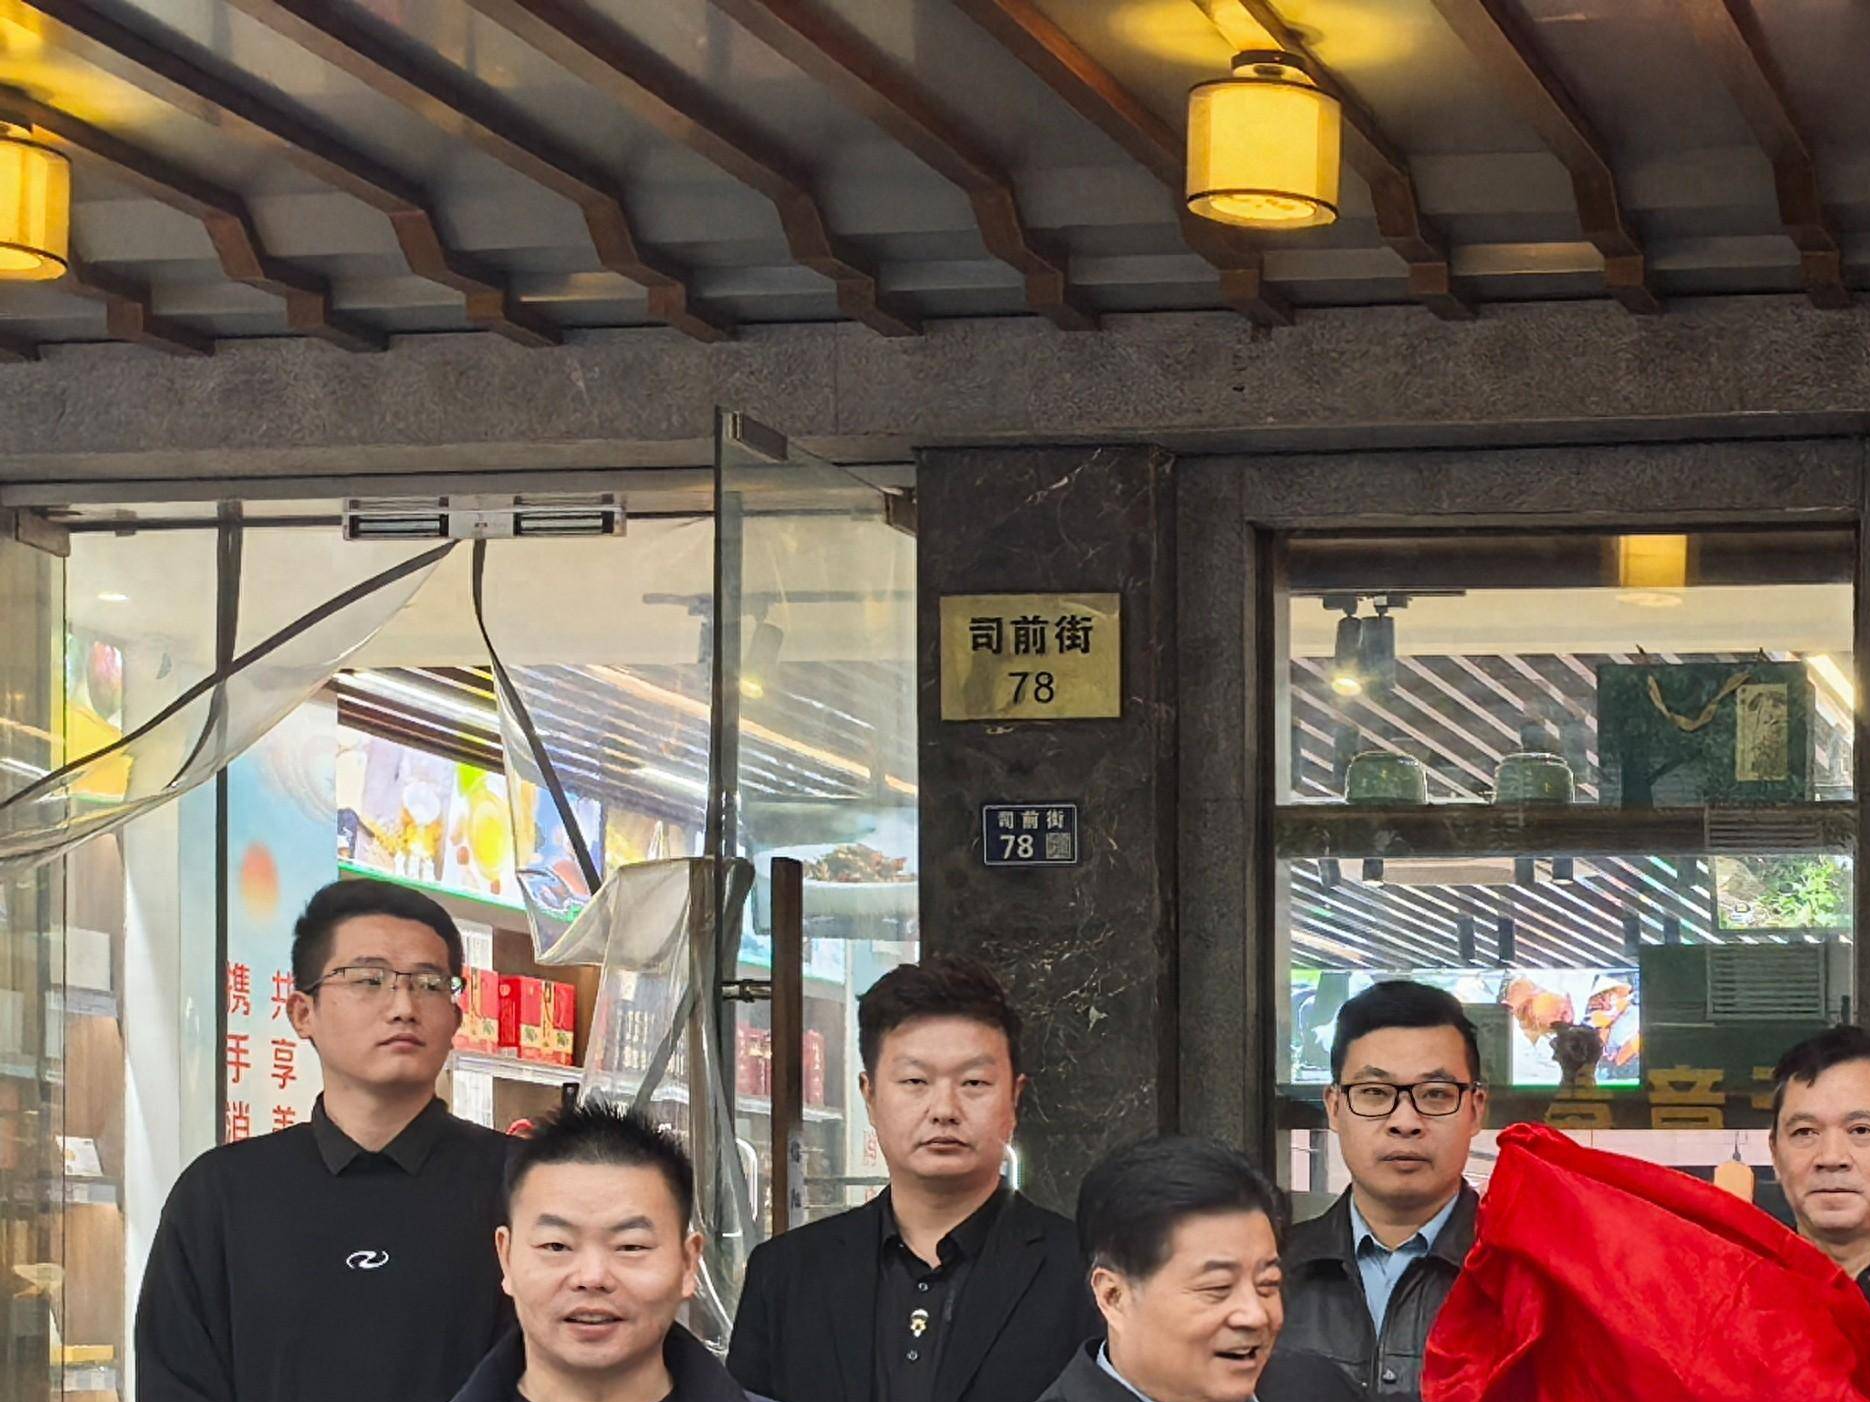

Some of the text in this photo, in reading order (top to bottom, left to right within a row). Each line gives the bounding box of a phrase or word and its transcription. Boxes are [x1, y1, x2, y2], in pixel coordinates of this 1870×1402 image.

[968, 614, 1094, 655] 司前街
[1007, 670, 1055, 705] 78
[997, 810, 1065, 830] 司前街
[999, 833, 1035, 860] 78
